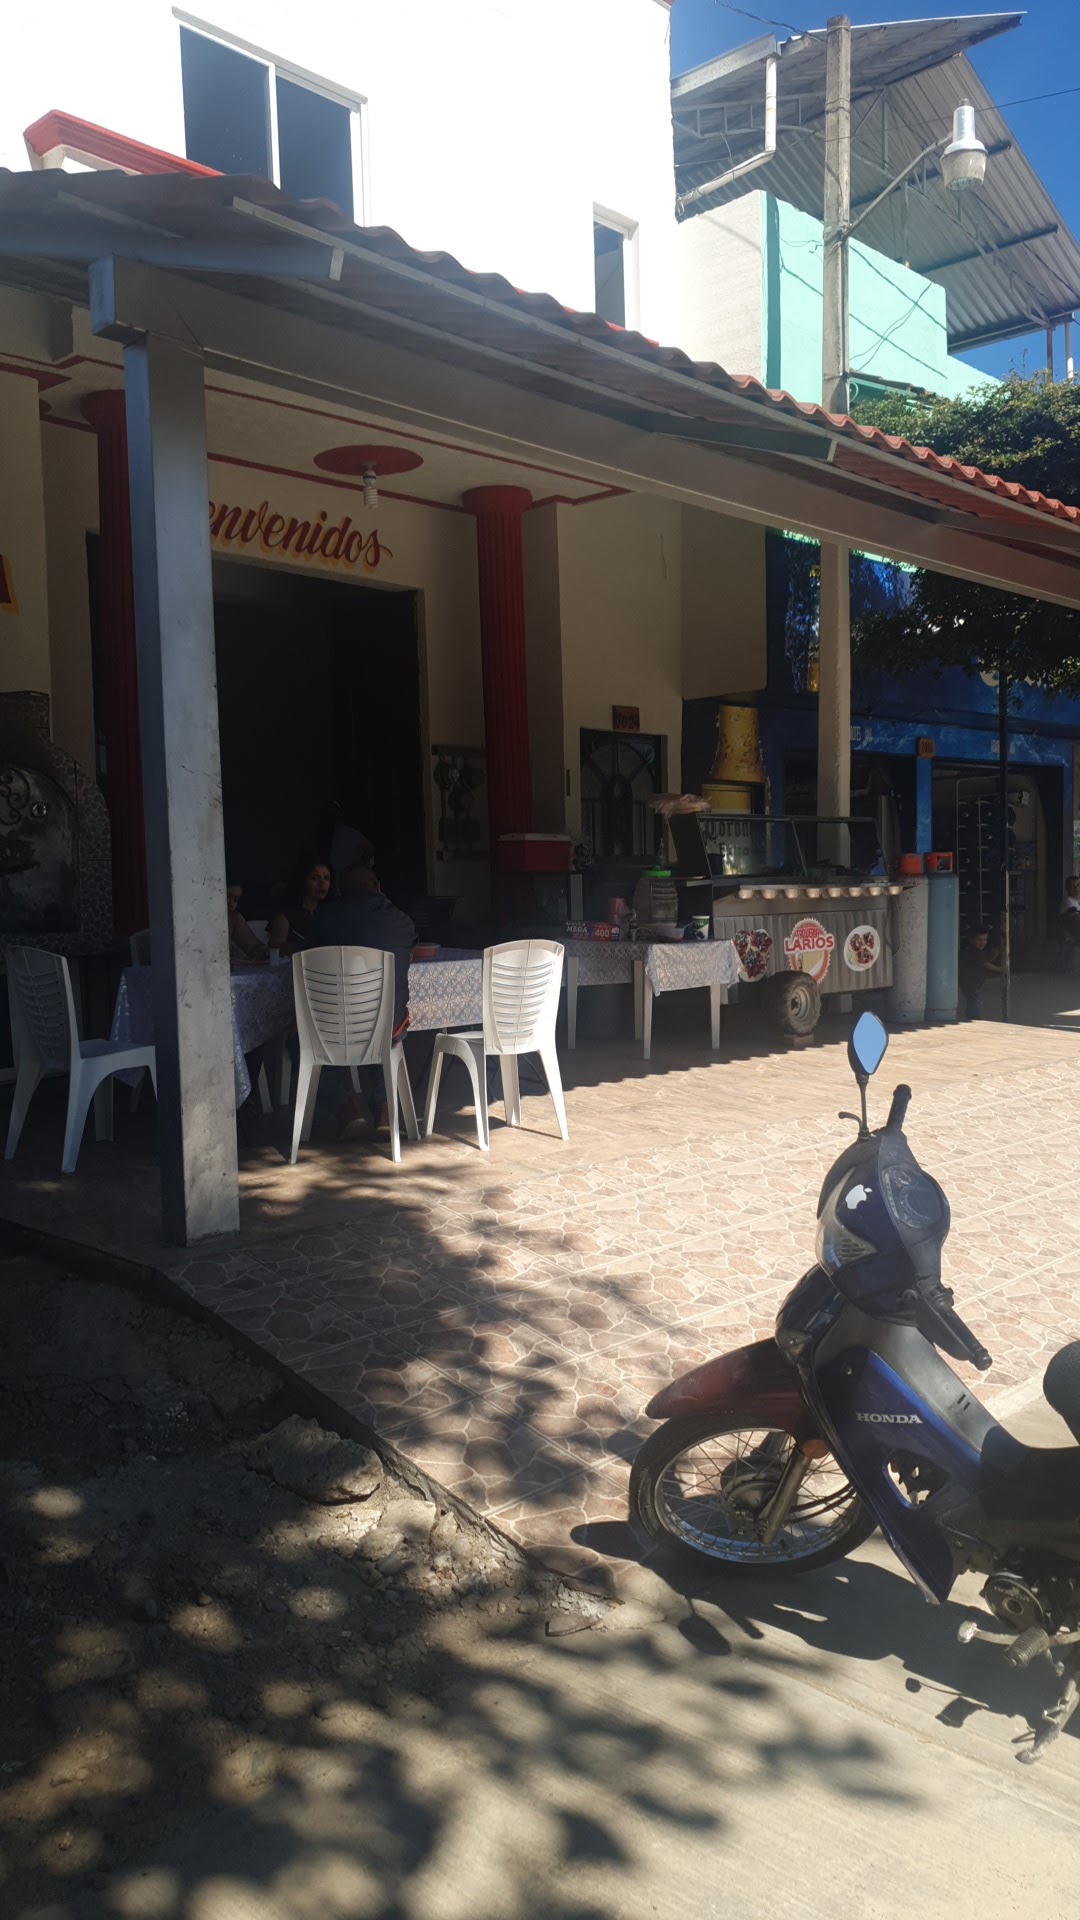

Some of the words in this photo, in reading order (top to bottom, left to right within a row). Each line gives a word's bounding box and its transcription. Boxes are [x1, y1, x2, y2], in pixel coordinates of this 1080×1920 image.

[208, 500, 393, 567] nvenidos
[566, 925, 588, 933] MEGA
[594, 928, 610, 938] 400
[784, 935, 834, 952] LARIOS
[855, 1411, 924, 1424] HONDA
